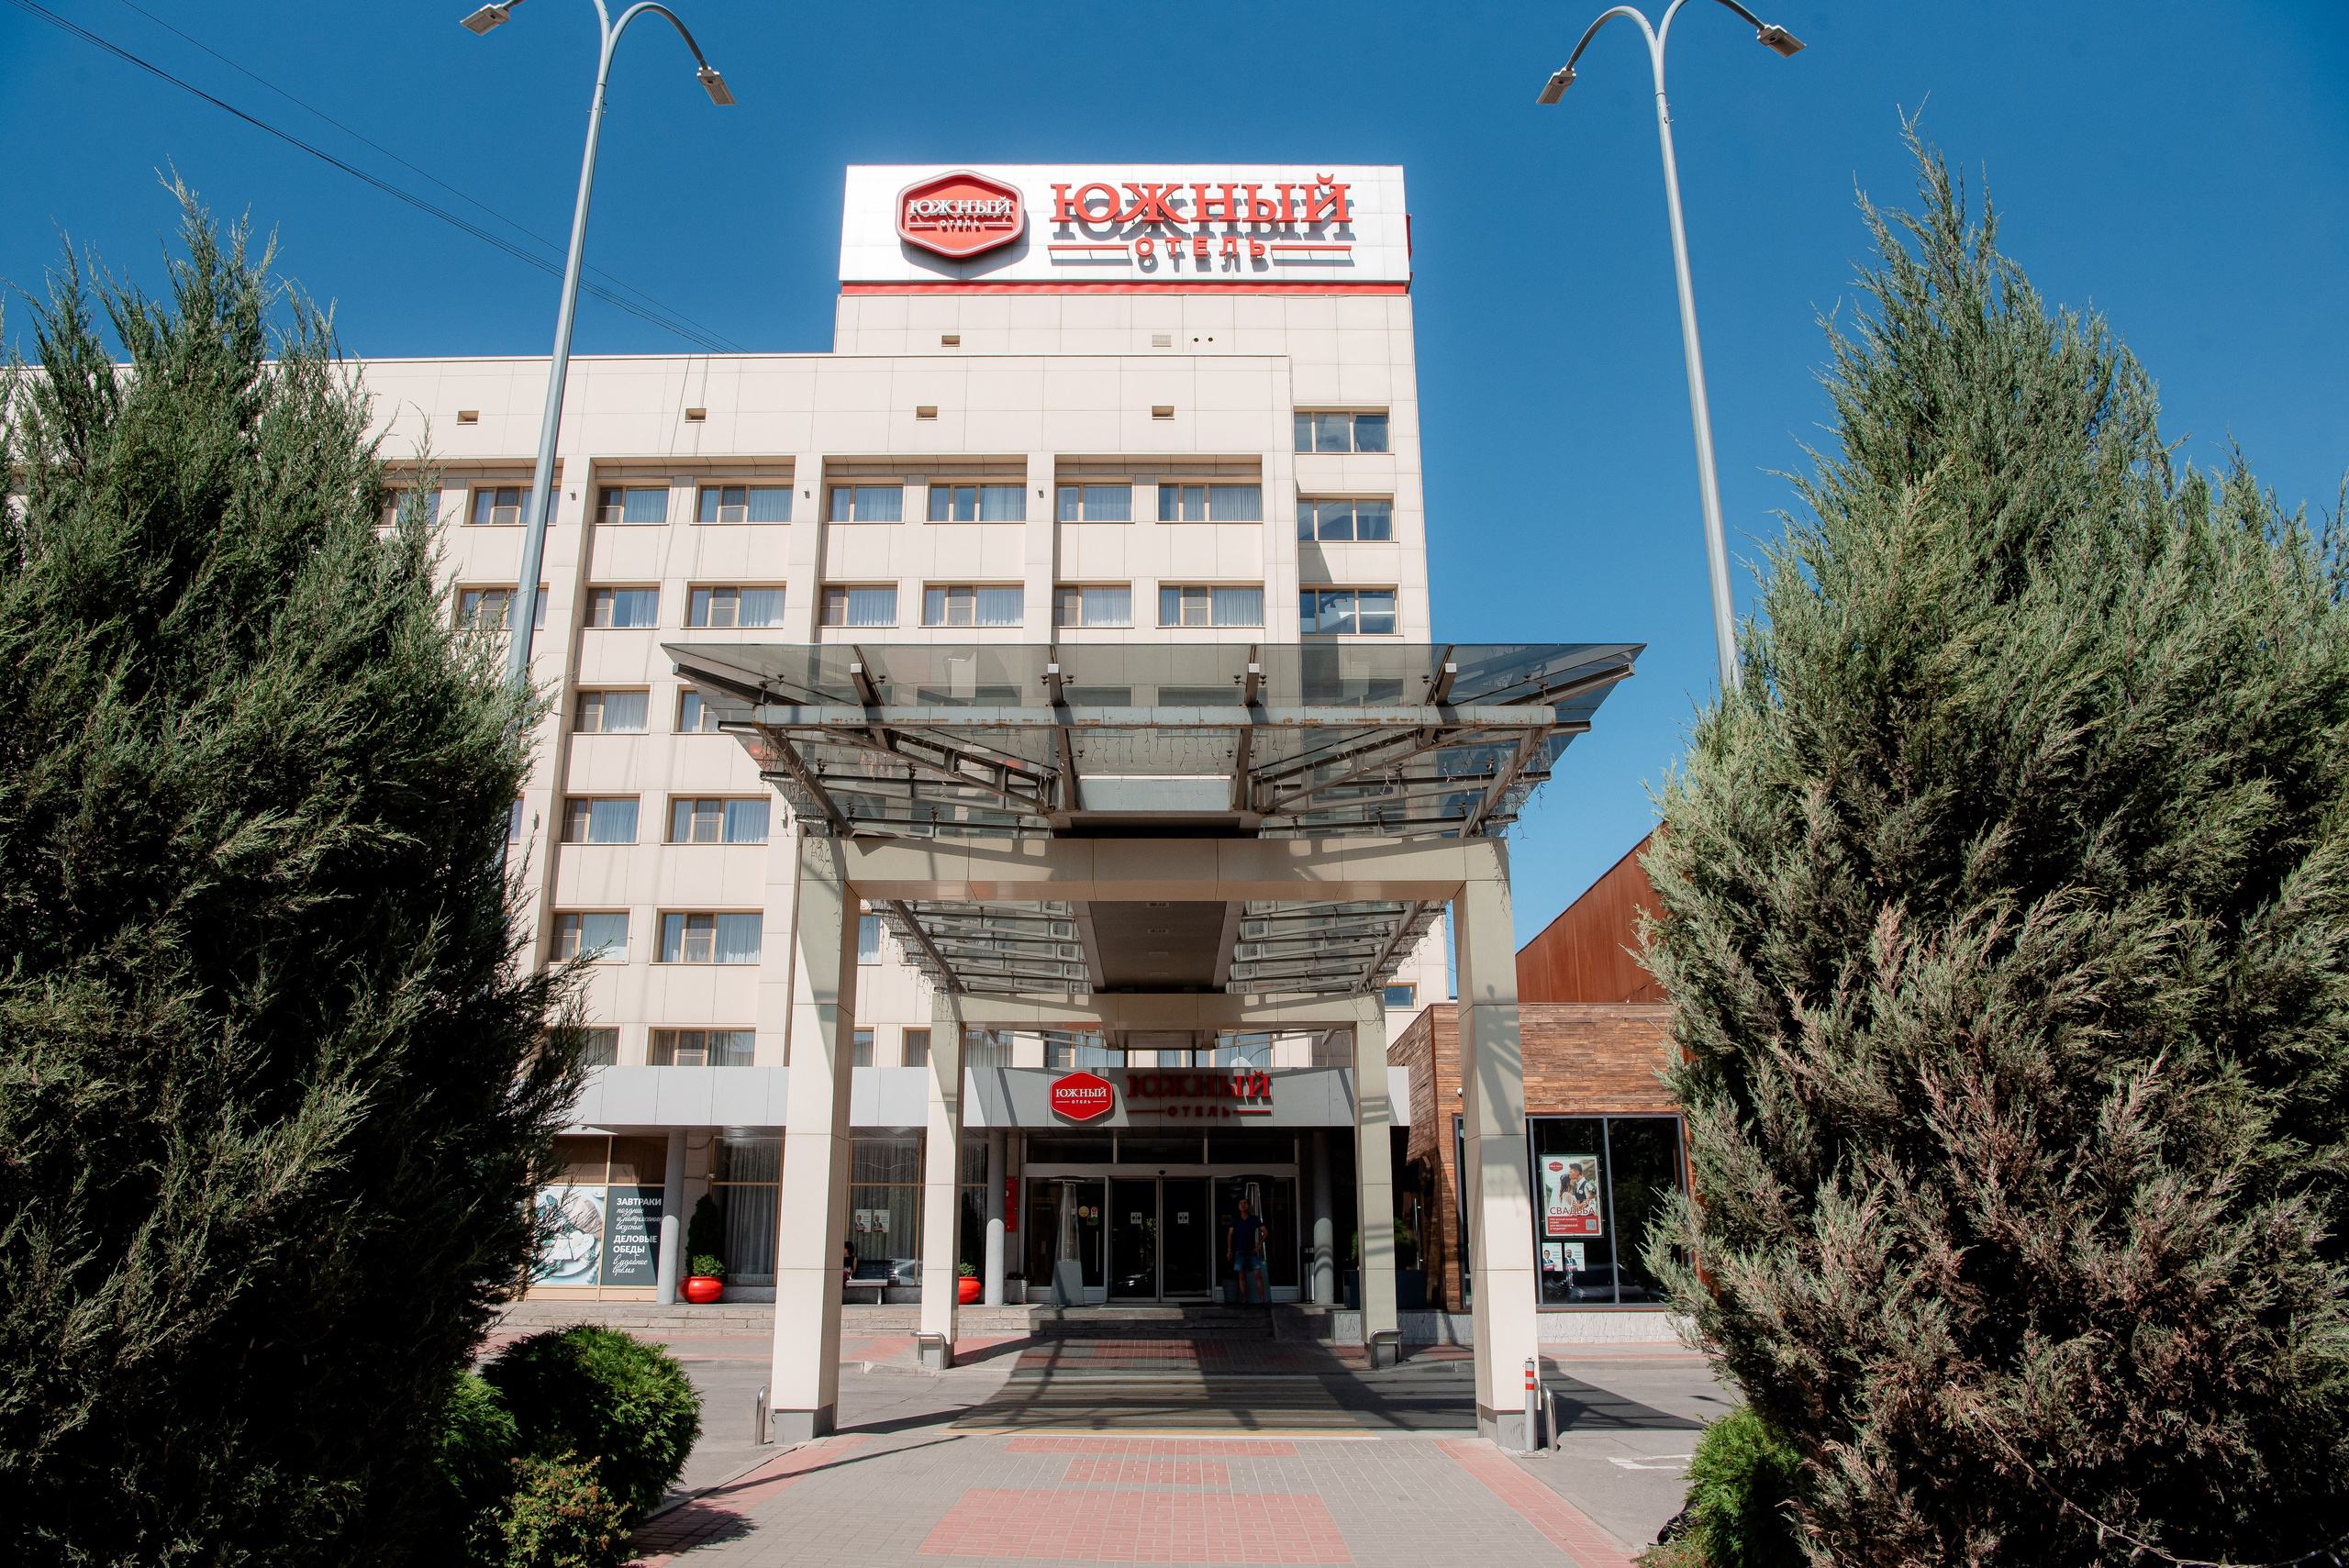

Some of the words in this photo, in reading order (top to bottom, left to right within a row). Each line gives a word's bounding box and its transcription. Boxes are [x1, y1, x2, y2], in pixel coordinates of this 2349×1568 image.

[1050, 172, 1353, 223] ЮЖНЫЙ
[907, 195, 1012, 216] ЮЖНЫЙ
[940, 219, 980, 228] ОТЕЛЬ
[1135, 236, 1265, 258] ОТЕЛЬ
[1126, 1069, 1272, 1098] ЮЖНЫЙ
[1055, 1086, 1108, 1098] ЮЖНЫЙ
[1167, 1106, 1231, 1118] ОТЕЛЬ
[616, 1197, 662, 1206] ЗАВТРАКИ
[1549, 1207, 1596, 1216] СВАДЬБА
[613, 1235, 657, 1244] ДЕЛОВЫЕ
[613, 1245, 645, 1254] ОБЕДЫ
